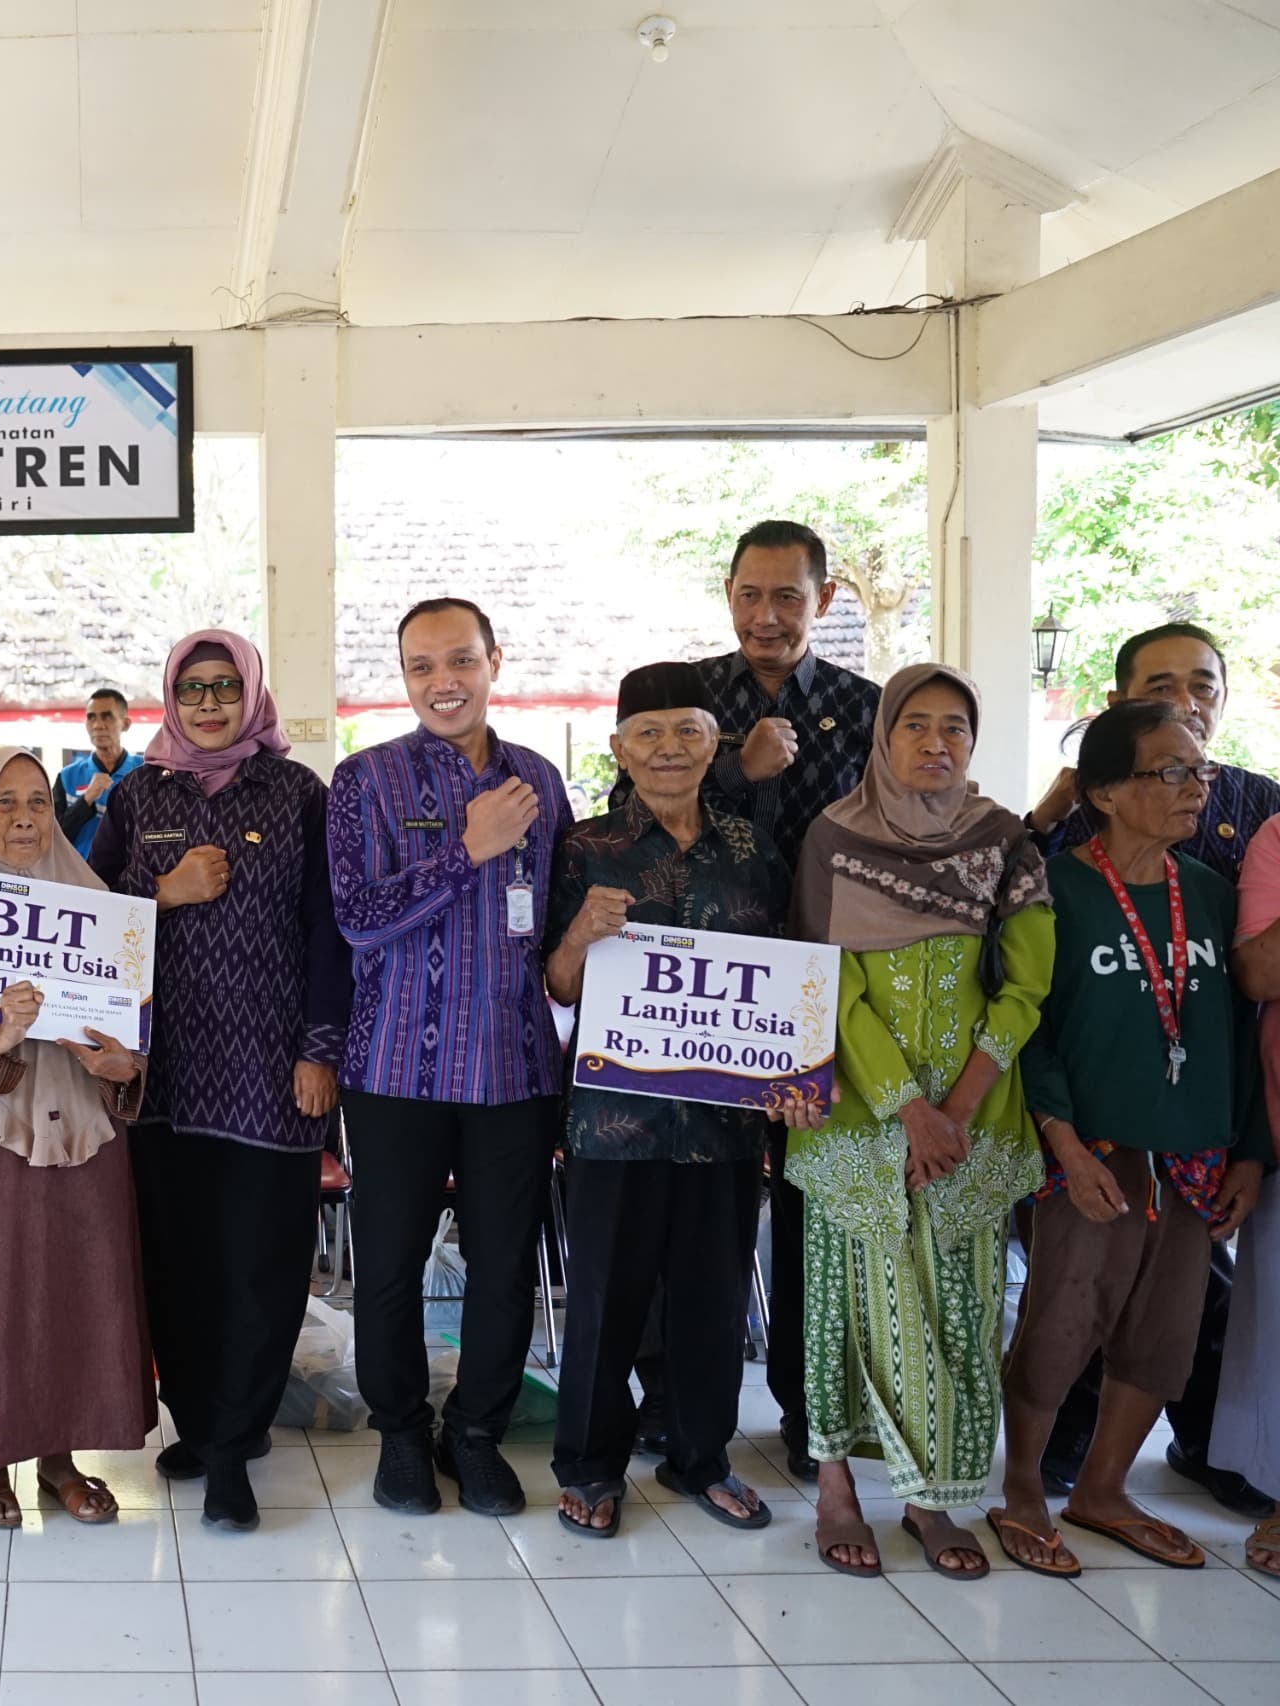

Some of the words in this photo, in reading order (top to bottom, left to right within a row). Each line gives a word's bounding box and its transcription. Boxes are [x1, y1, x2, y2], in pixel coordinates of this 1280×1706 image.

[618, 930, 655, 943] Mapan
[61, 951, 119, 980] Usia
[641, 951, 771, 1006] BLT
[1140, 978, 1200, 993] PRS
[620, 995, 721, 1029] Lanjut
[732, 1008, 796, 1037] Usia
[604, 1029, 650, 1058] Rp.
[661, 1037, 811, 1075] 1.000.000,-
